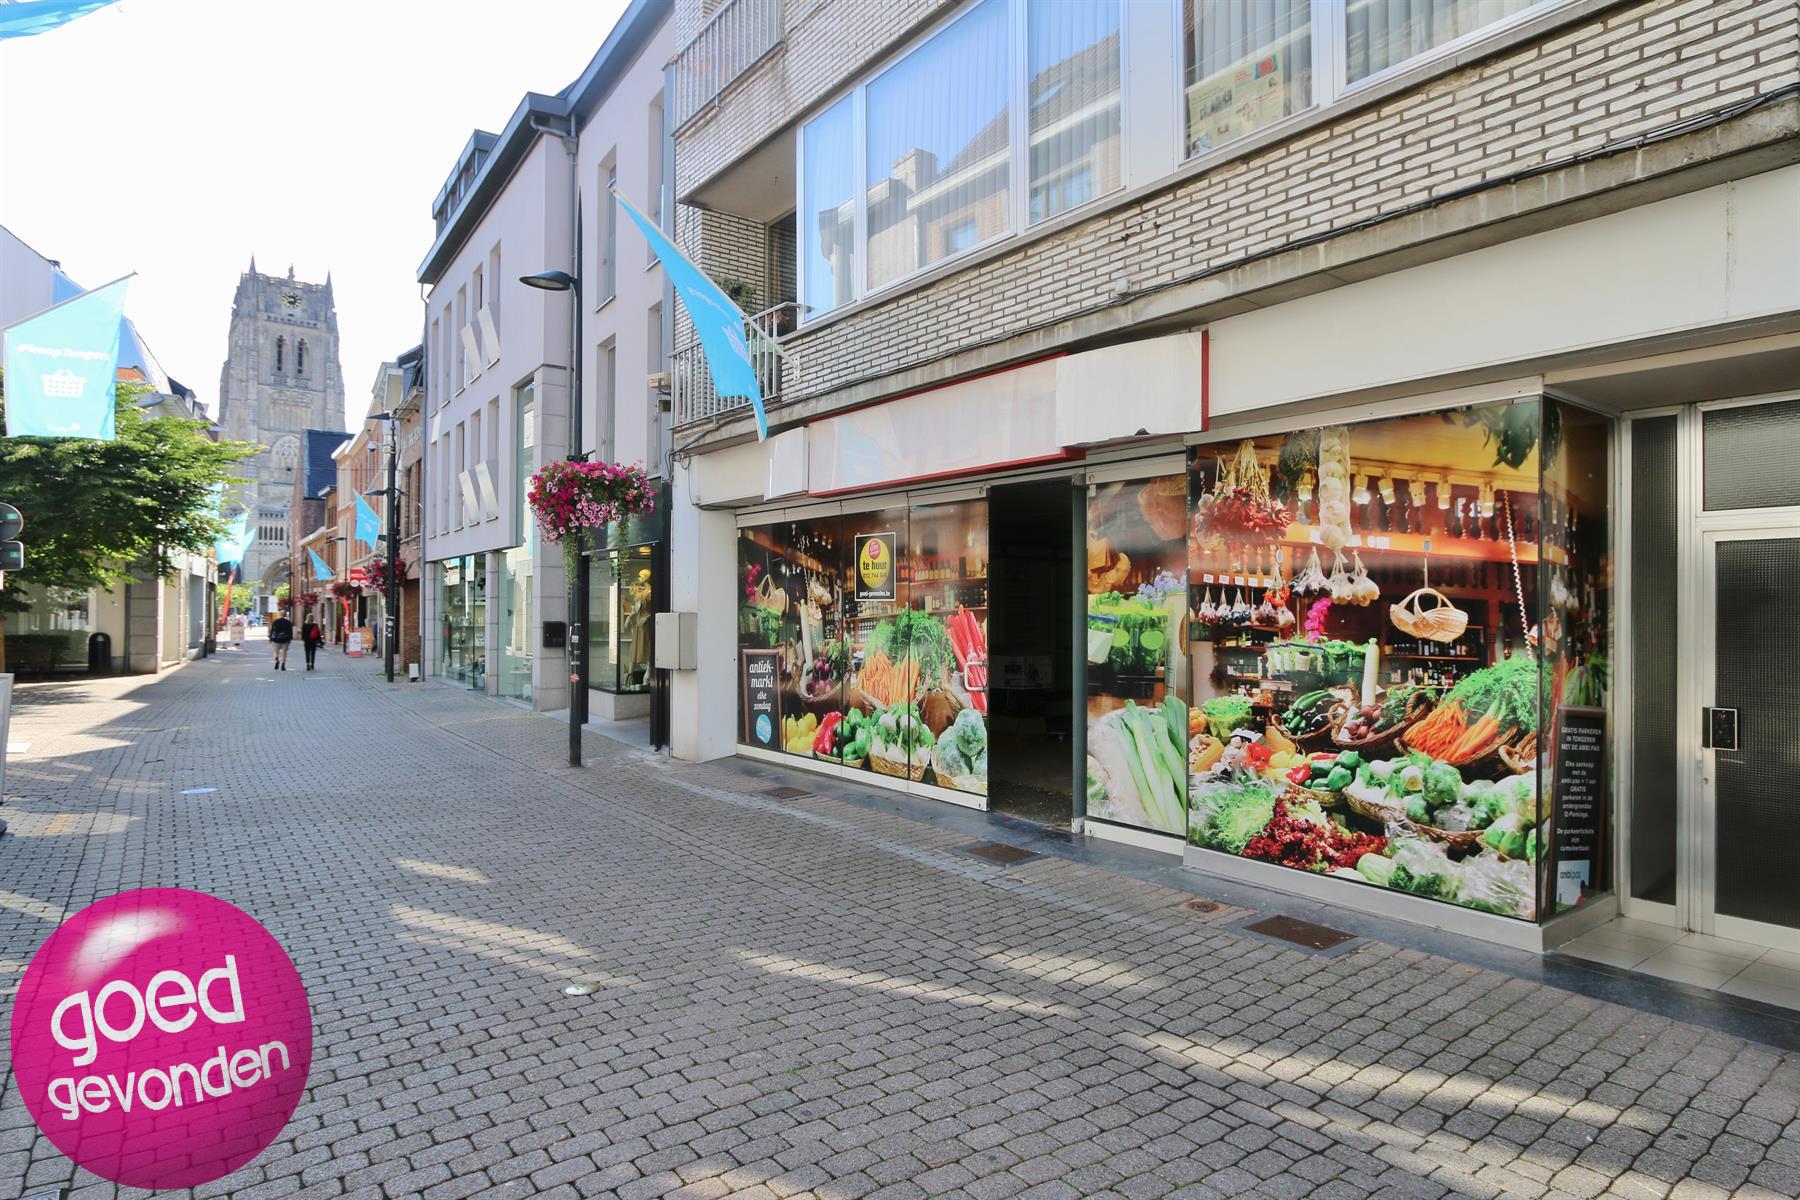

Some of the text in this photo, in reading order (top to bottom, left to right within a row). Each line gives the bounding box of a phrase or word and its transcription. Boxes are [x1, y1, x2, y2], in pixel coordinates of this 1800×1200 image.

[863, 561, 887, 570] te huur
[749, 660, 774, 674] antiek-
[751, 675, 773, 688] markt
[757, 691, 767, 700] elke
[754, 701, 771, 712] zondag
